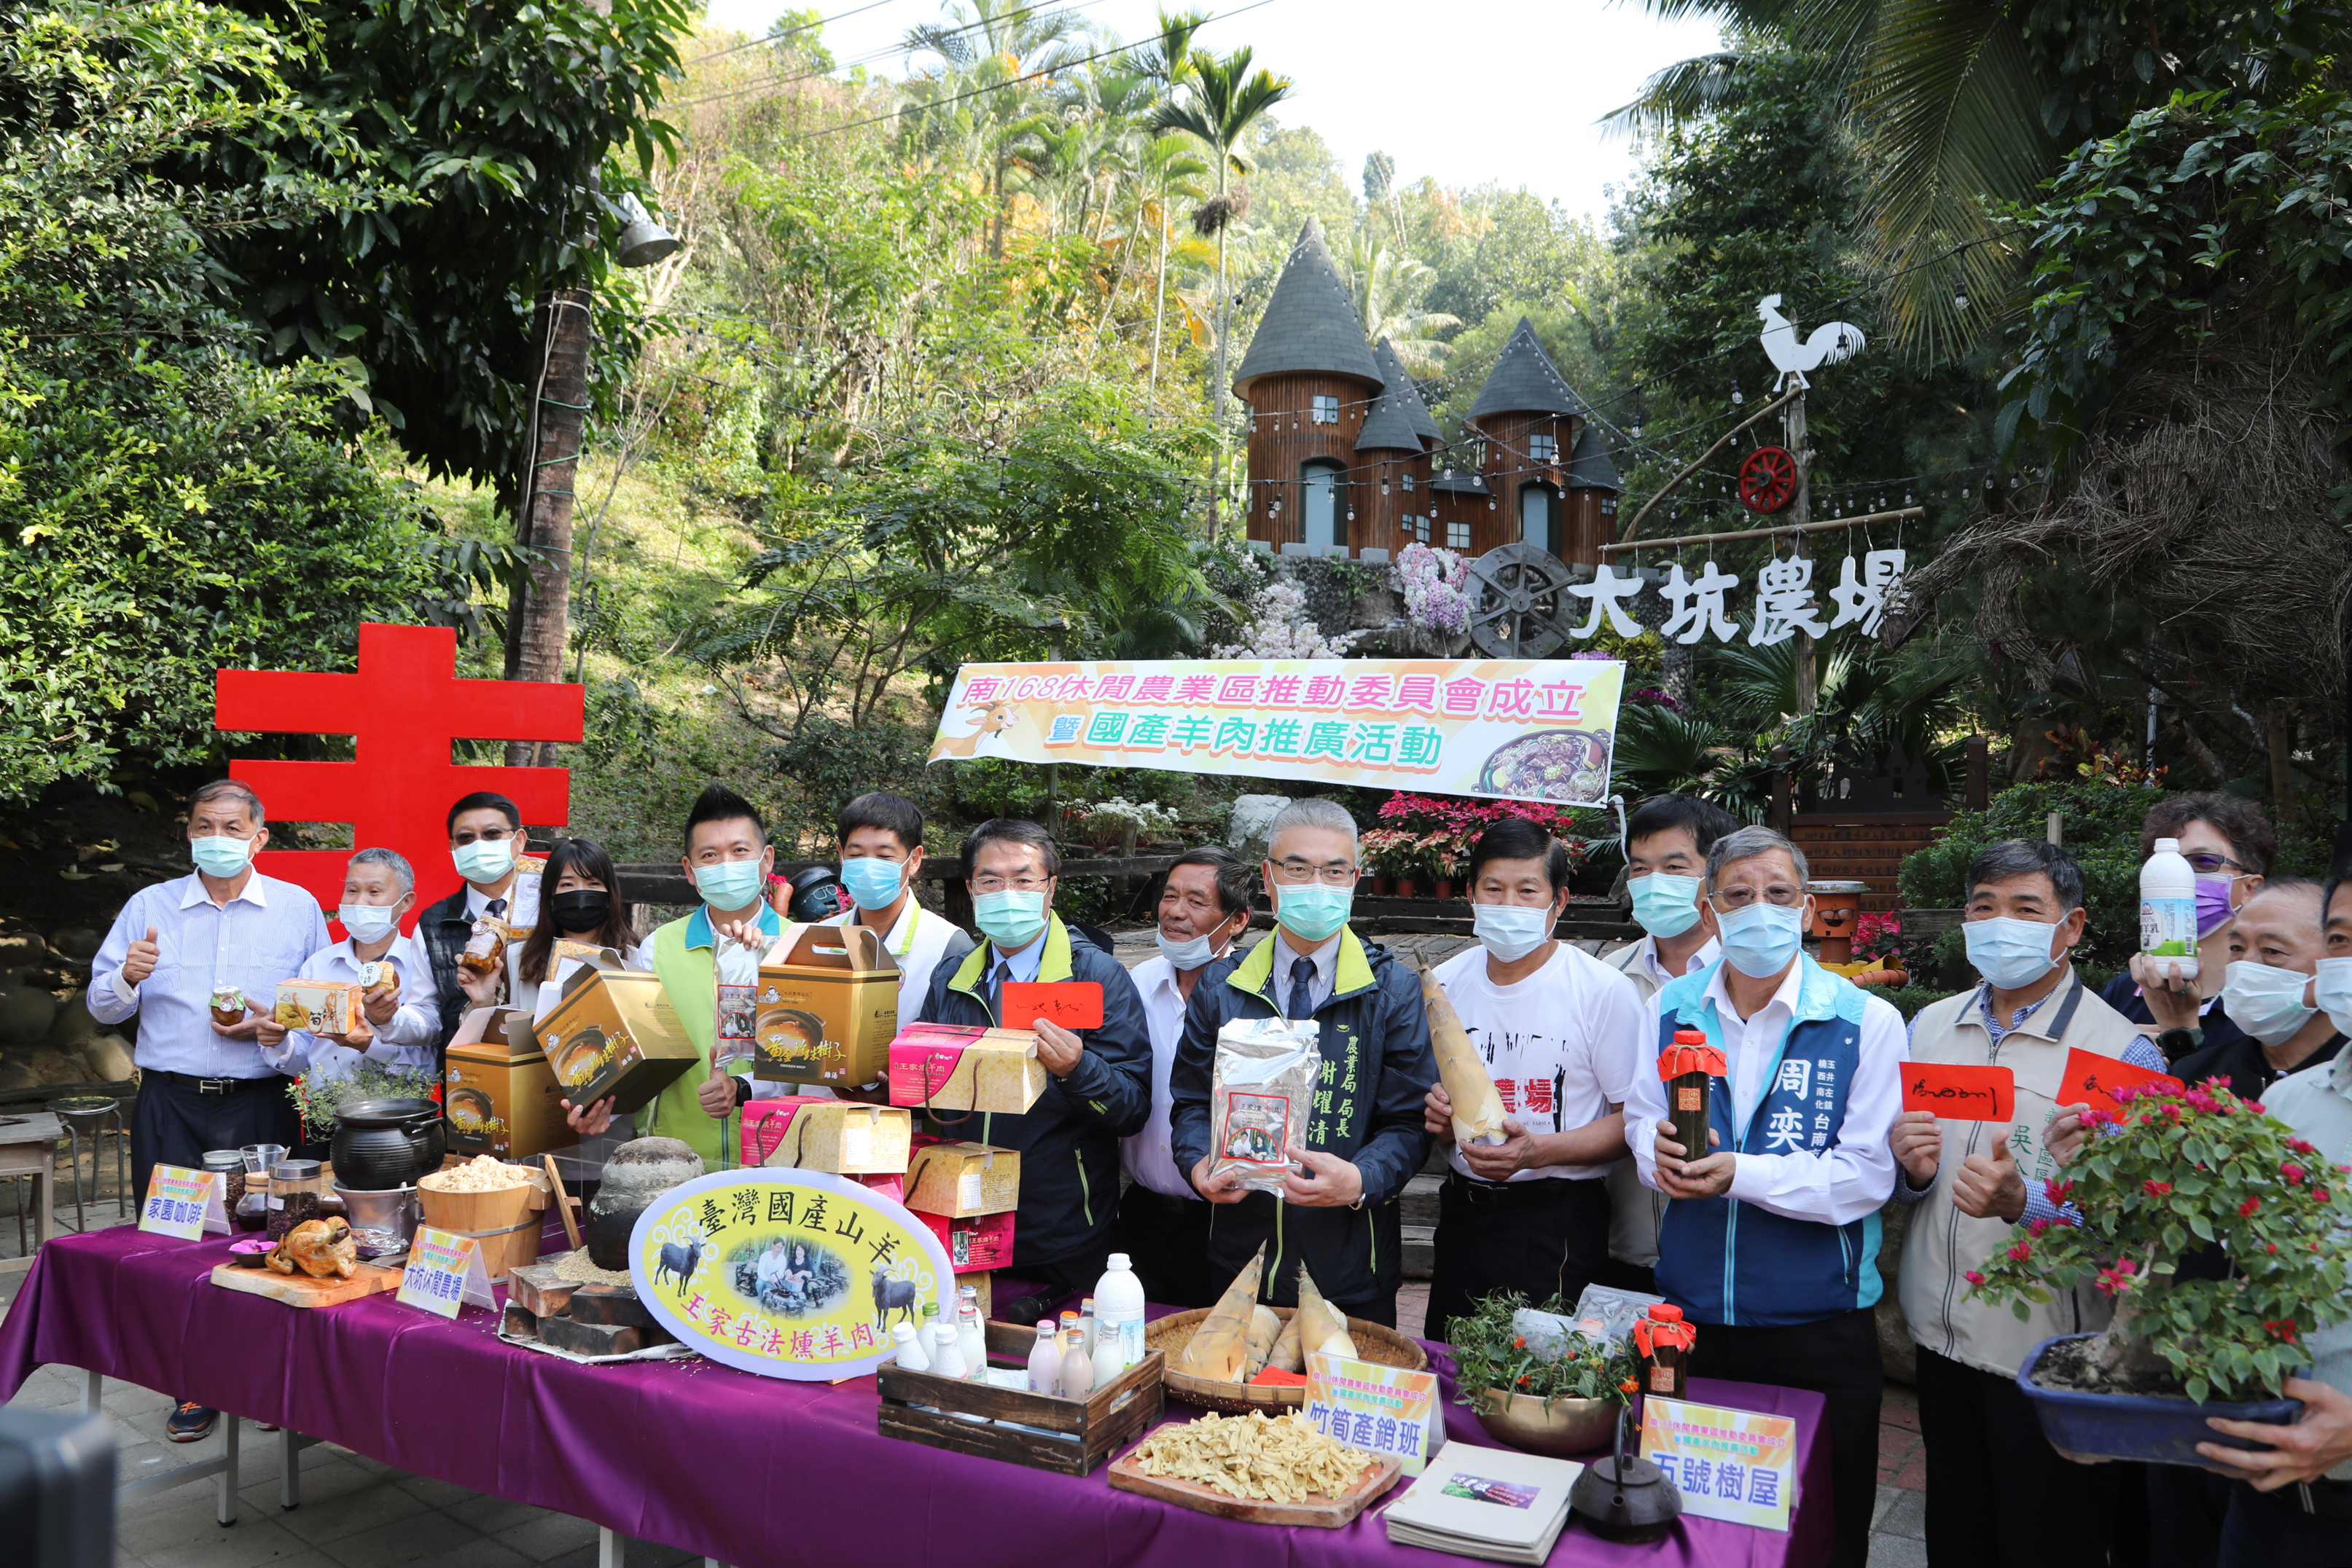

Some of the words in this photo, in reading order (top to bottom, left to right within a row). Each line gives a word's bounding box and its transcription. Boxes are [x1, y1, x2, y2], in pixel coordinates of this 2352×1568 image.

[1567, 549, 1907, 647] 大坑農場
[961, 674, 1583, 716] 南168休閒農業區推動委員會成立
[1049, 712, 1442, 766] 暨國產羊肉推廣活動
[1340, 1035, 1359, 1093] 農業局
[1335, 1099, 1354, 1138] 局長
[147, 1197, 203, 1226] 家園咖啡
[699, 1188, 901, 1265] 臺灣國產山羊
[404, 1263, 463, 1301] 大坑休閒農場
[680, 1293, 874, 1360] 王家古法燻羊肉
[1312, 1372, 1427, 1402] 南168休閒農業區推動委員會成立
[1310, 1402, 1421, 1457] 竹筍產銷班
[1652, 1452, 1779, 1508] 五號樹屋
